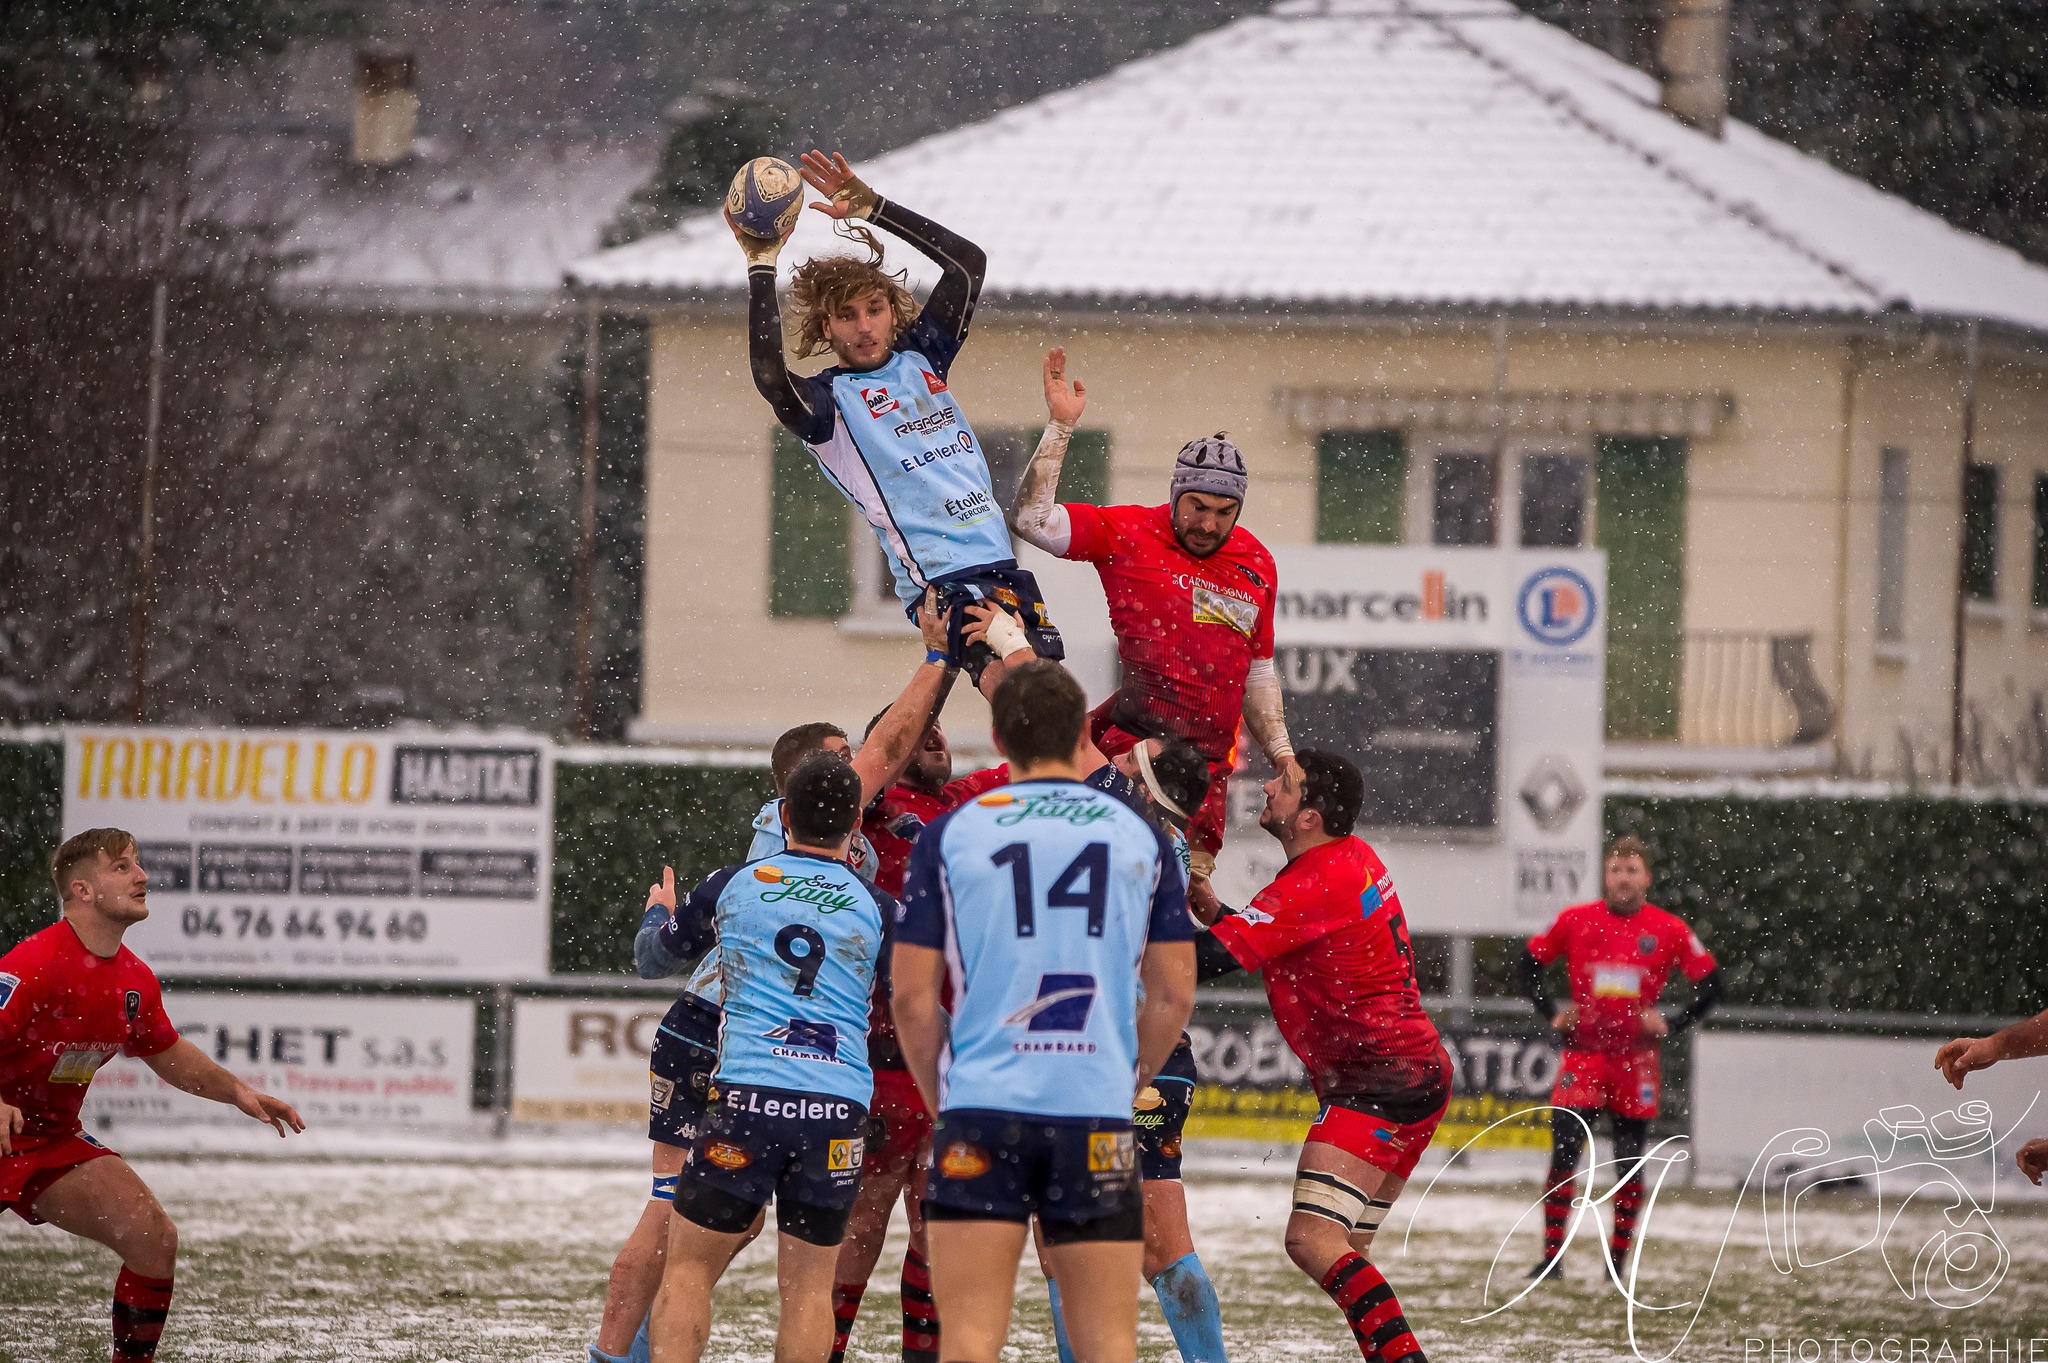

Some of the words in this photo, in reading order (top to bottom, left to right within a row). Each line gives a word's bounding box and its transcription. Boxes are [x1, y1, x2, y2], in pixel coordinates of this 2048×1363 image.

[957, 504, 991, 522] VERCORS
[76, 735, 377, 805] TARAVELLO
[989, 841, 1112, 939] 14
[180, 906, 225, 939] 04
[231, 906, 274, 940] 76
[282, 907, 326, 941] 64
[335, 907, 377, 942] 94
[384, 908, 429, 943] 60
[773, 923, 827, 997] 9
[1013, 1041, 1098, 1056] CHAMBARD
[726, 1089, 850, 1120] E.Leclerc
